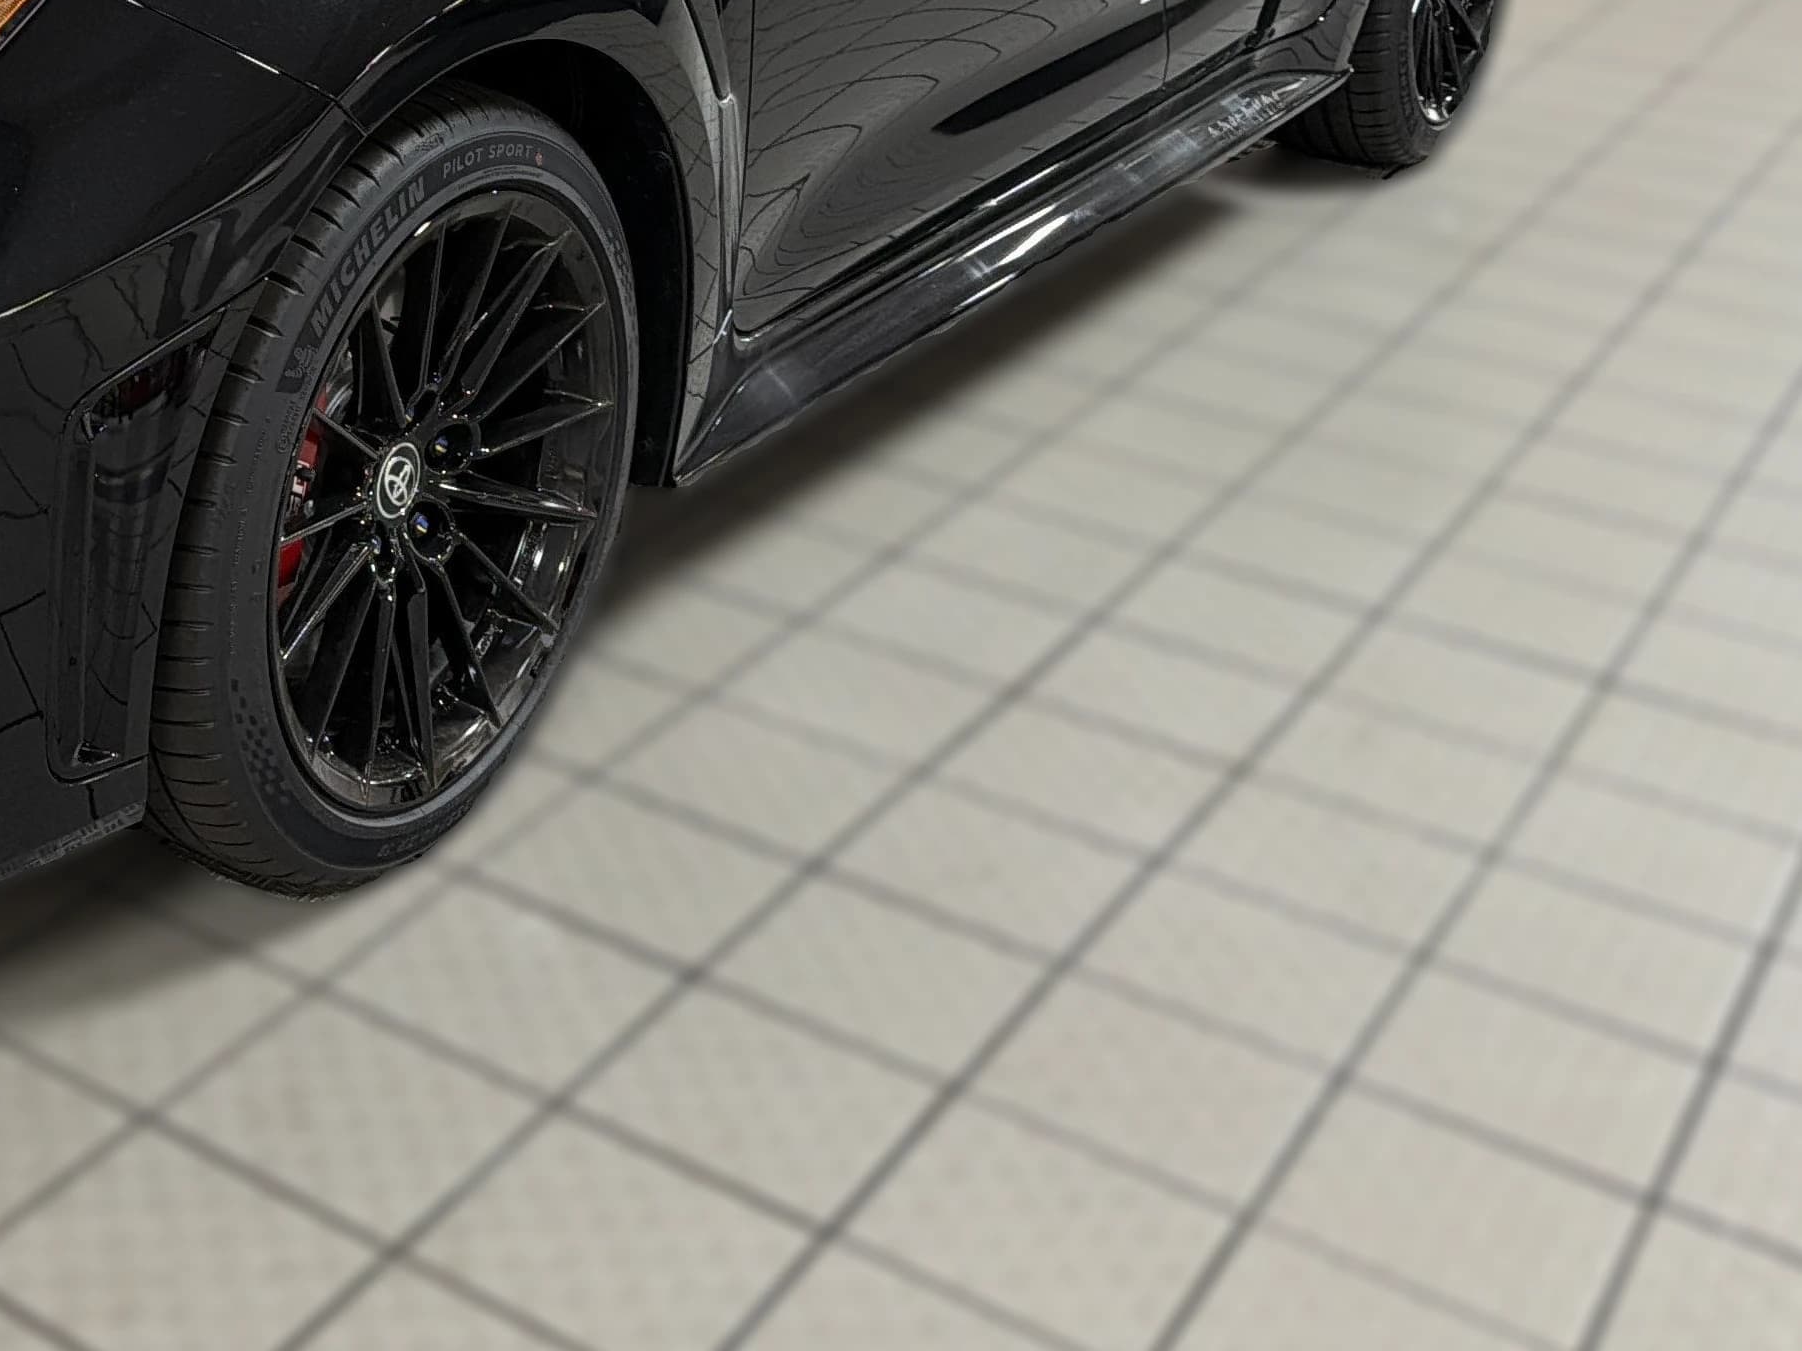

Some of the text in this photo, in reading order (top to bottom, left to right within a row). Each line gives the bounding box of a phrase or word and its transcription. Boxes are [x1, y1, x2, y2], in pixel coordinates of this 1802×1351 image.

[310, 175, 426, 338] MICHELIN
[443, 149, 483, 179] PILOT
[488, 144, 533, 160] SPORT
